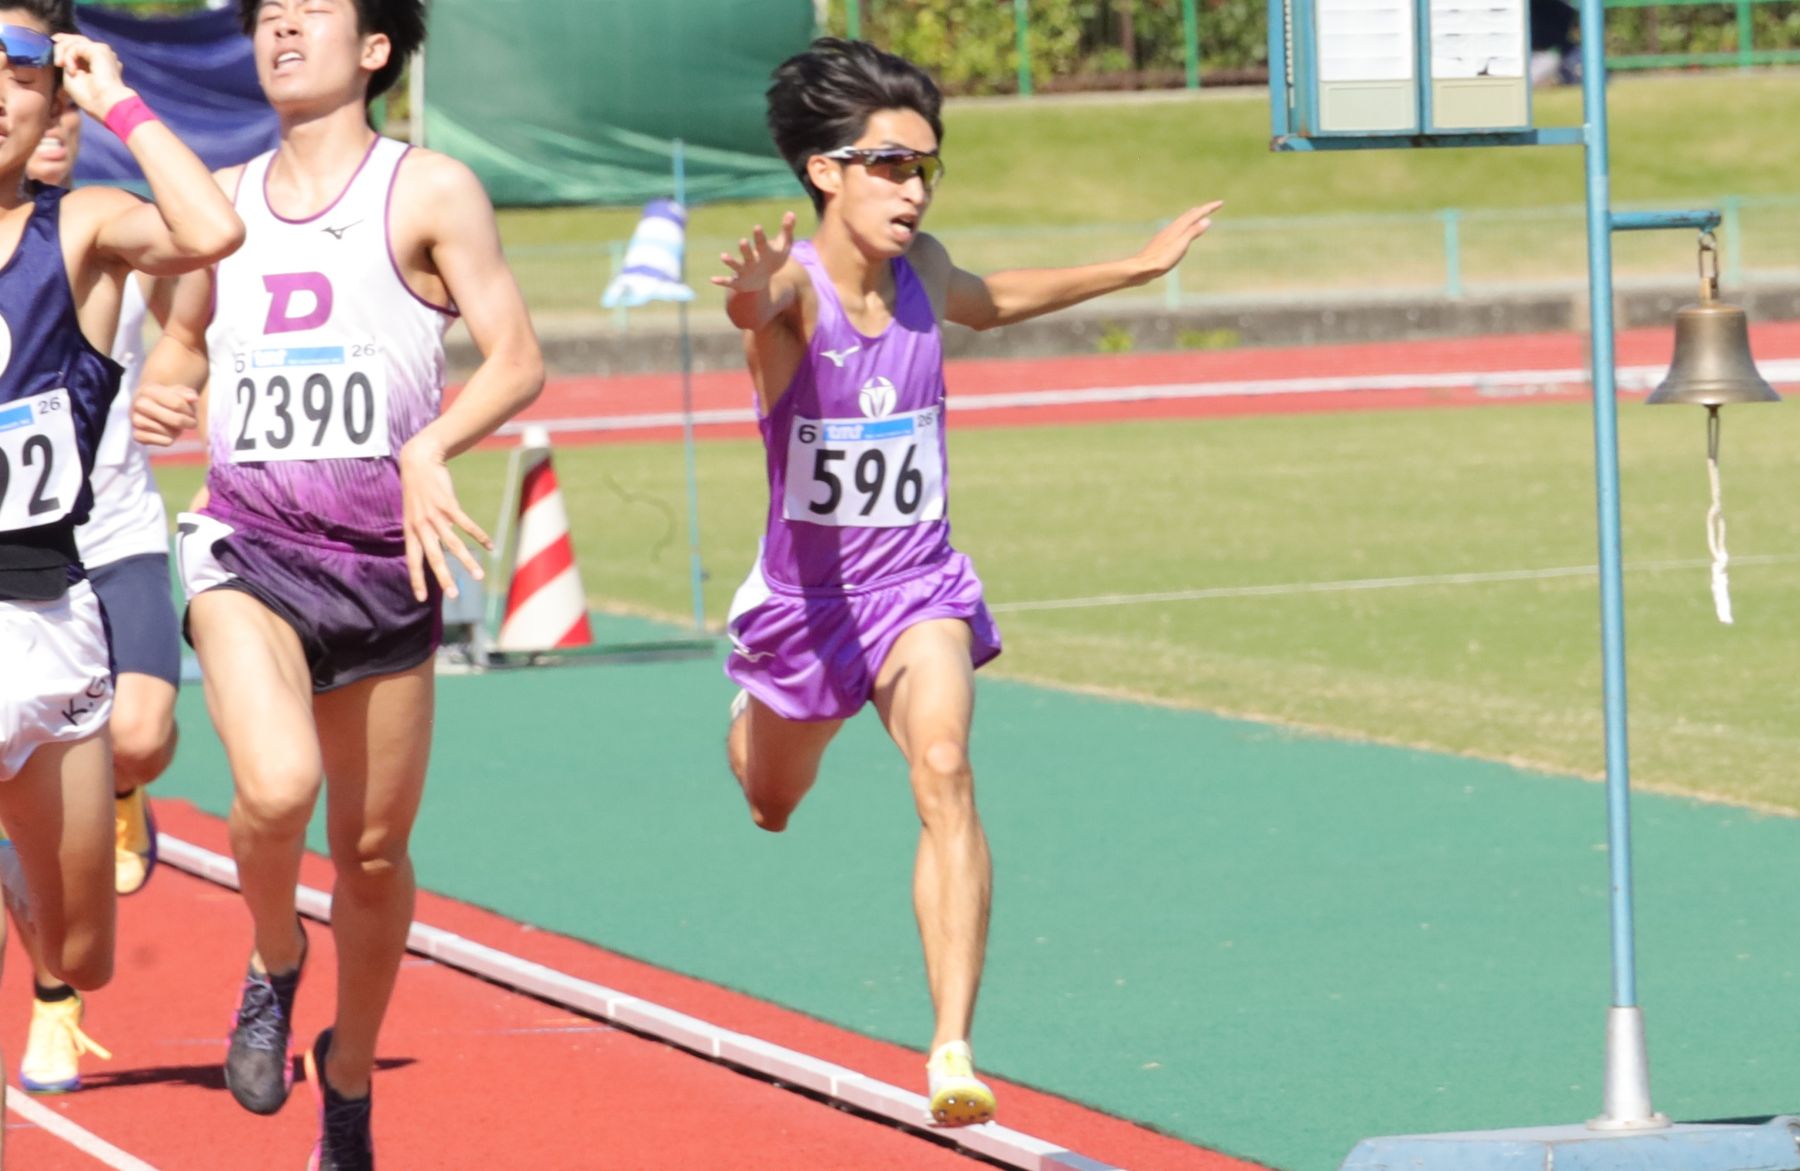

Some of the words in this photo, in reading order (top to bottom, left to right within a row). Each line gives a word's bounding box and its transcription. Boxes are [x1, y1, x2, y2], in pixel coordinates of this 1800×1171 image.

[262, 271, 334, 335] D
[352, 344, 376, 358] 26
[39, 397, 61, 414] 26
[235, 371, 375, 451] 2390
[798, 424, 817, 444] 6
[809, 444, 923, 516] 596
